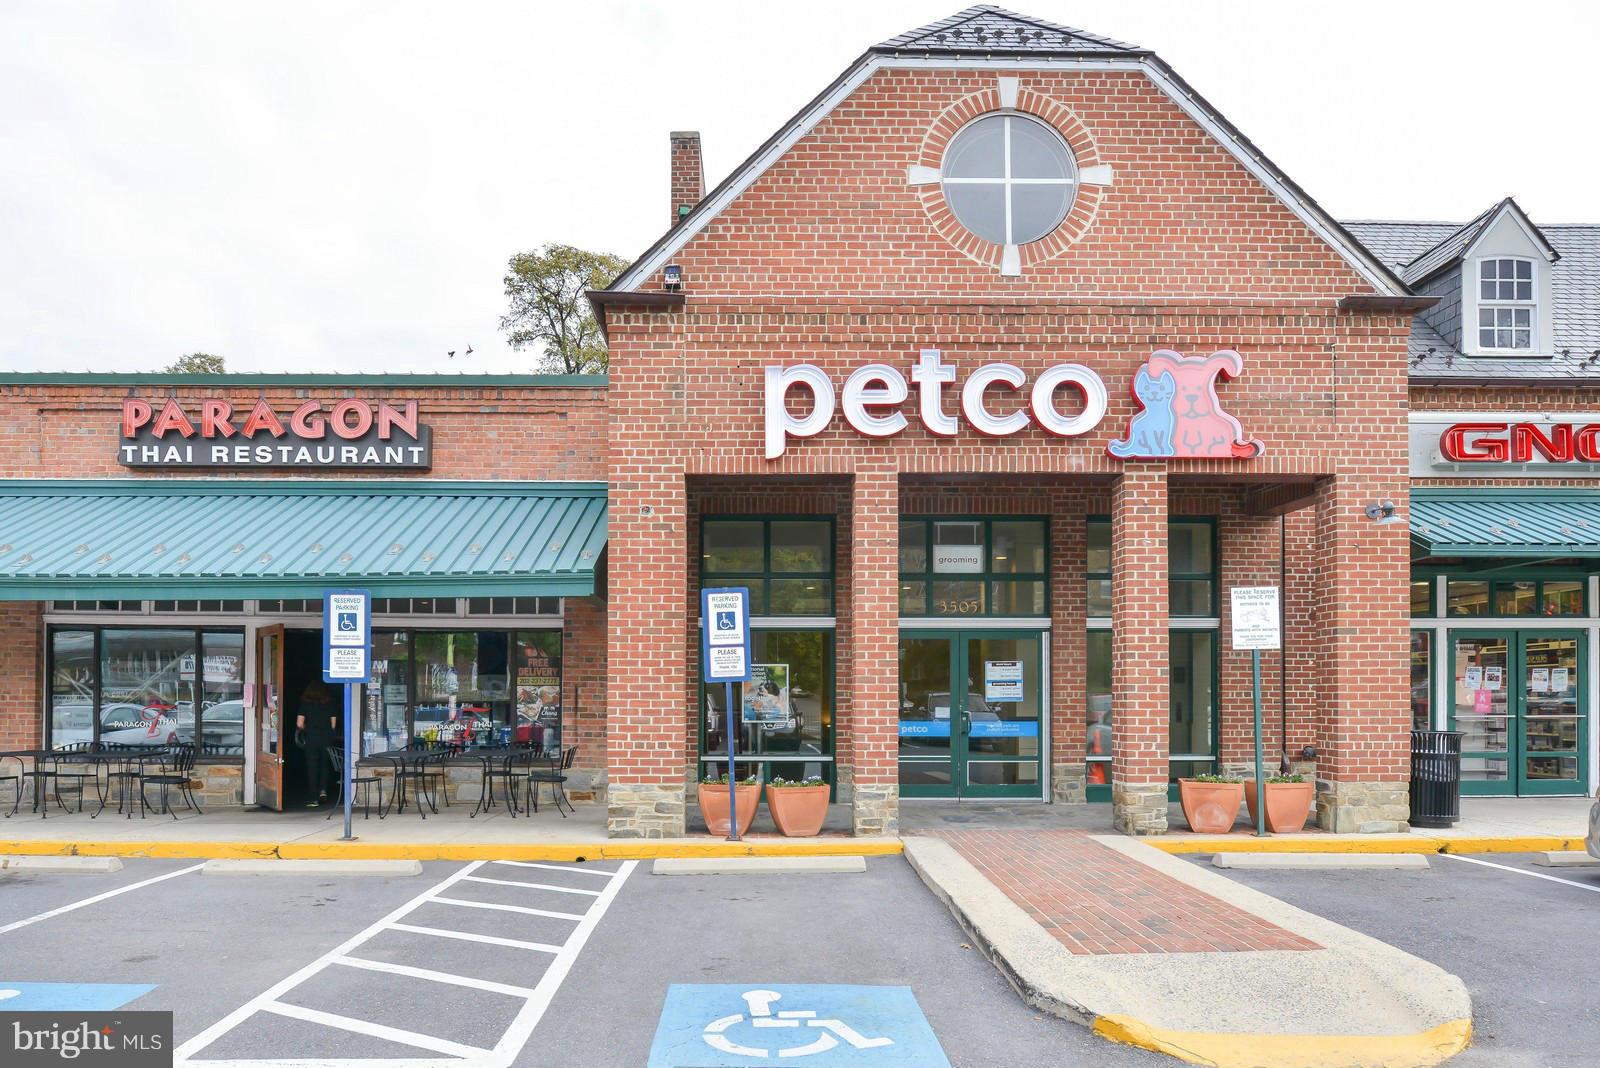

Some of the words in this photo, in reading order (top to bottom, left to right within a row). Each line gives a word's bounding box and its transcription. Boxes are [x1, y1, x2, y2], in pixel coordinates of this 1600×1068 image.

[765, 348, 1108, 460] petco
[121, 397, 419, 440] PARAGON
[122, 446, 193, 463] THAI
[211, 446, 424, 464] RESTAURANT
[938, 556, 978, 565] grooming
[939, 600, 978, 614] 3505
[528, 658, 549, 667] FREE
[518, 667, 558, 677] DELIVERY
[114, 720, 152, 728] PARAGON
[430, 723, 467, 731] PARAGON
[901, 724, 928, 734] petco
